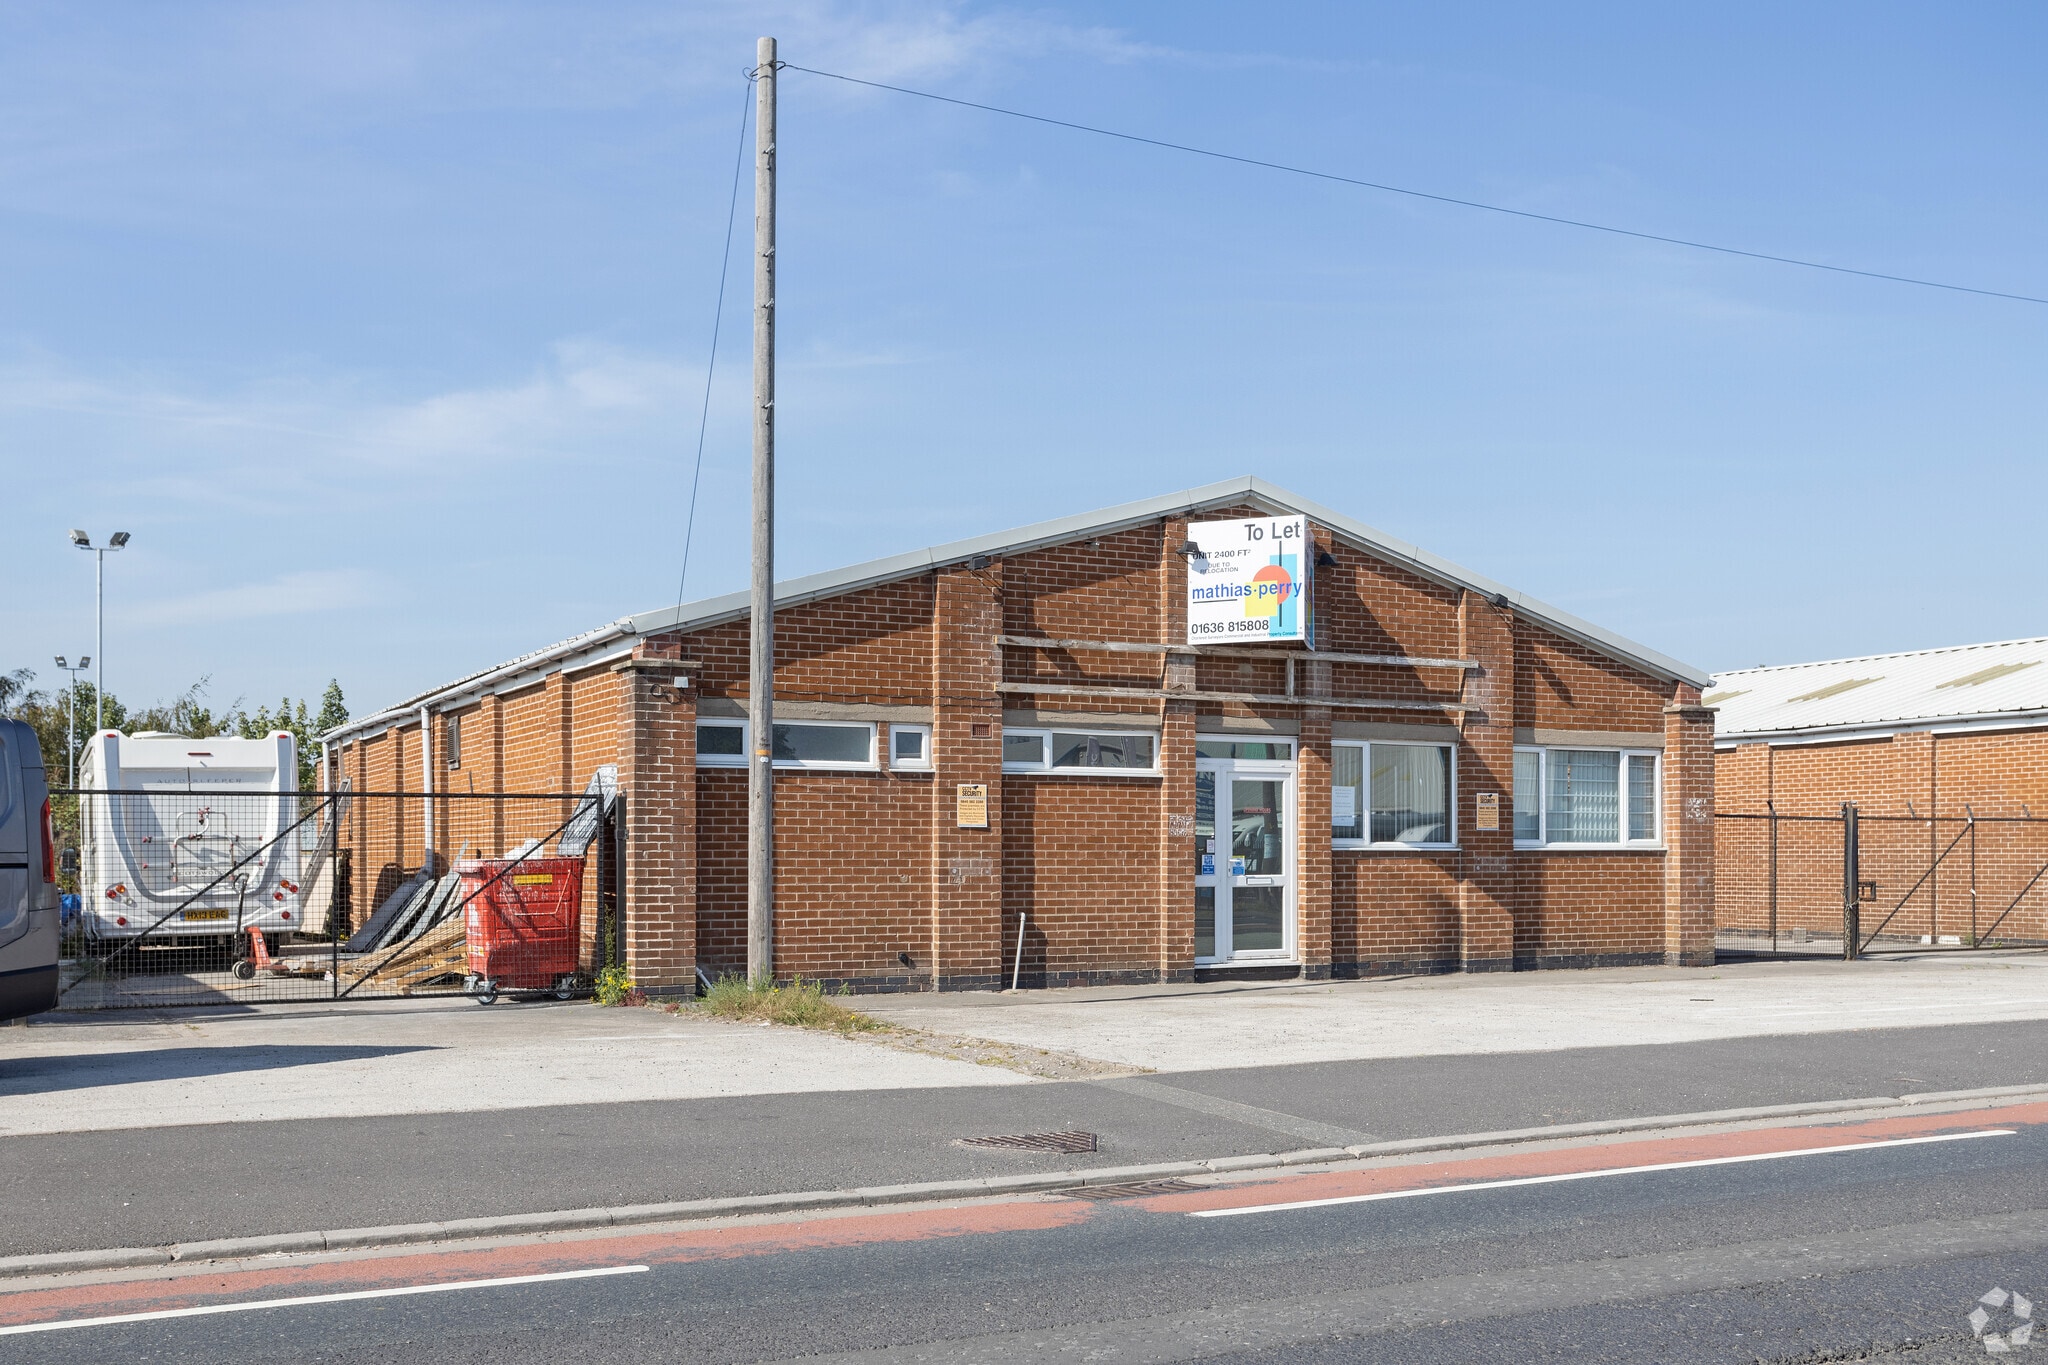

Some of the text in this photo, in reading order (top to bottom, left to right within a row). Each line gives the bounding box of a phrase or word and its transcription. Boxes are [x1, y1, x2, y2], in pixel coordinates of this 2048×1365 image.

[1244, 521, 1301, 541] To Let
[1192, 550, 1212, 560] UNIT
[1214, 550, 1235, 559] 2400
[1200, 567, 1239, 575] RELOCATION
[1191, 620, 1269, 634] 01636 815808
